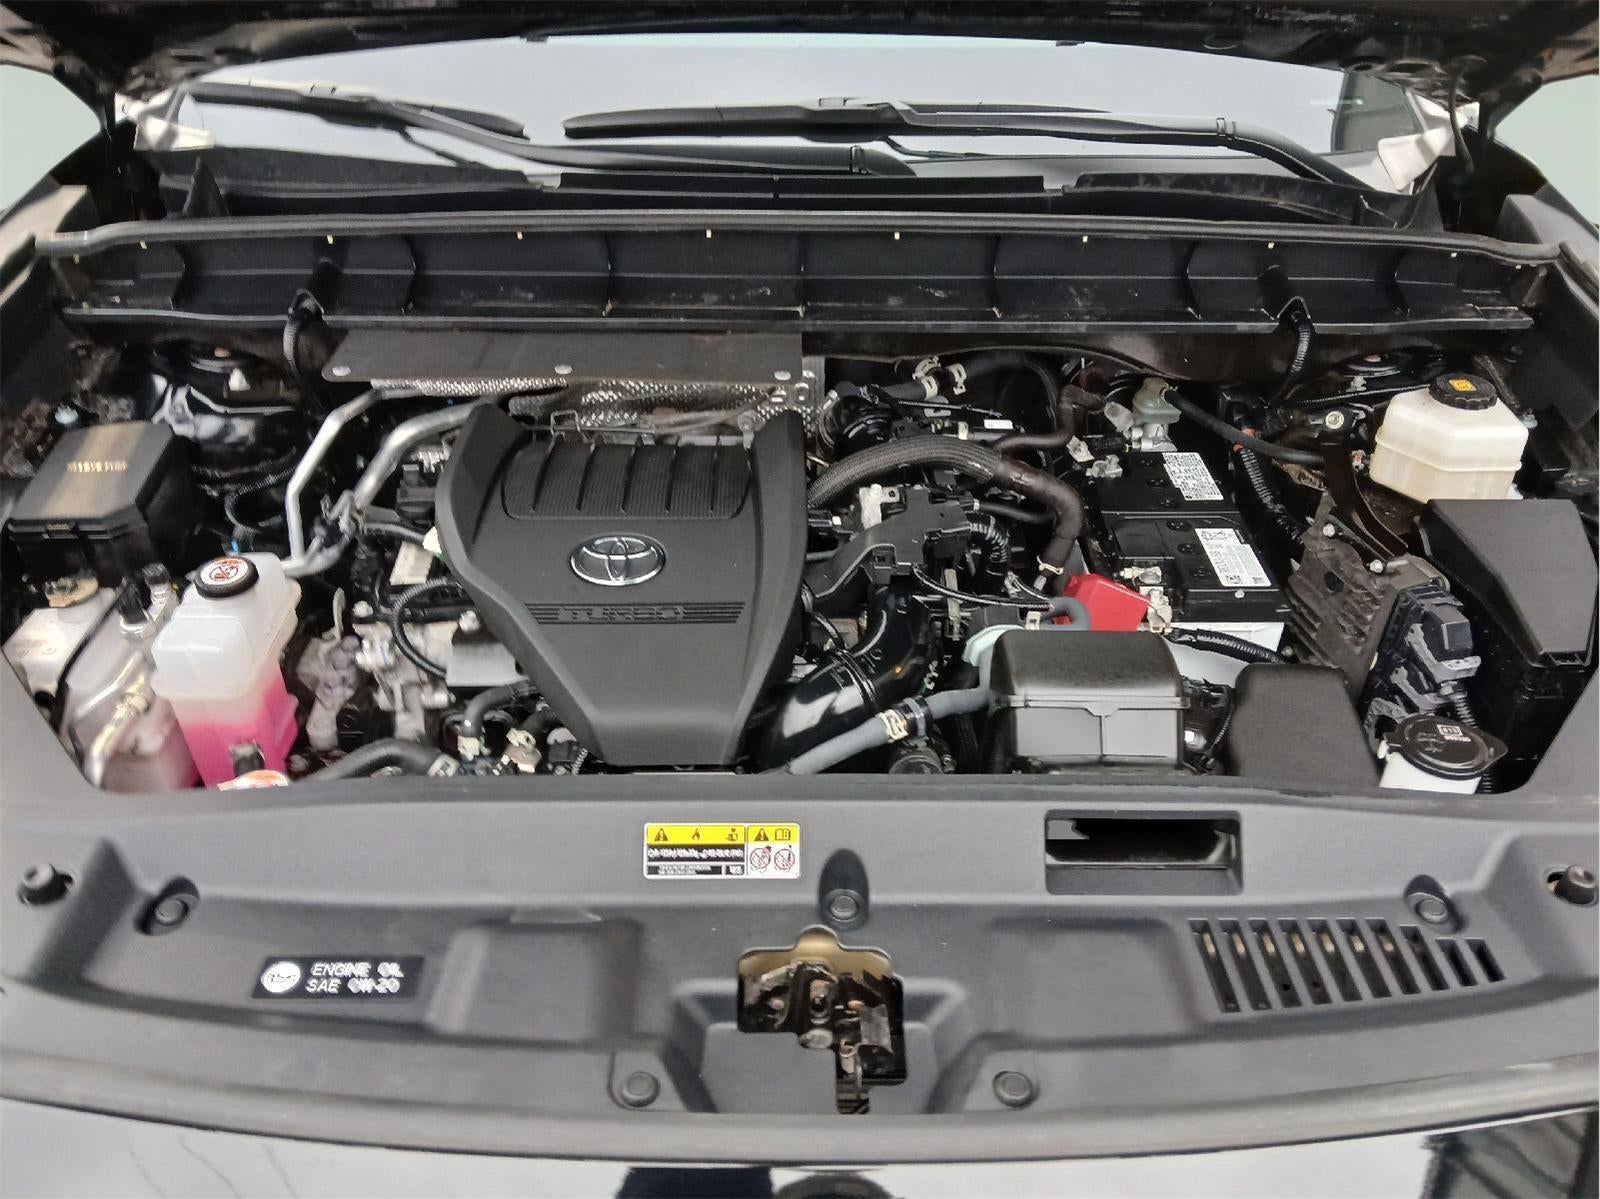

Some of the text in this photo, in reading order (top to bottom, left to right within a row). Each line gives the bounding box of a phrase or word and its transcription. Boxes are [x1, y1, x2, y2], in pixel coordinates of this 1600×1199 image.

[561, 605, 685, 622] TURBO
[311, 961, 404, 978] ENGINE OIL
[305, 977, 342, 994] SAE
